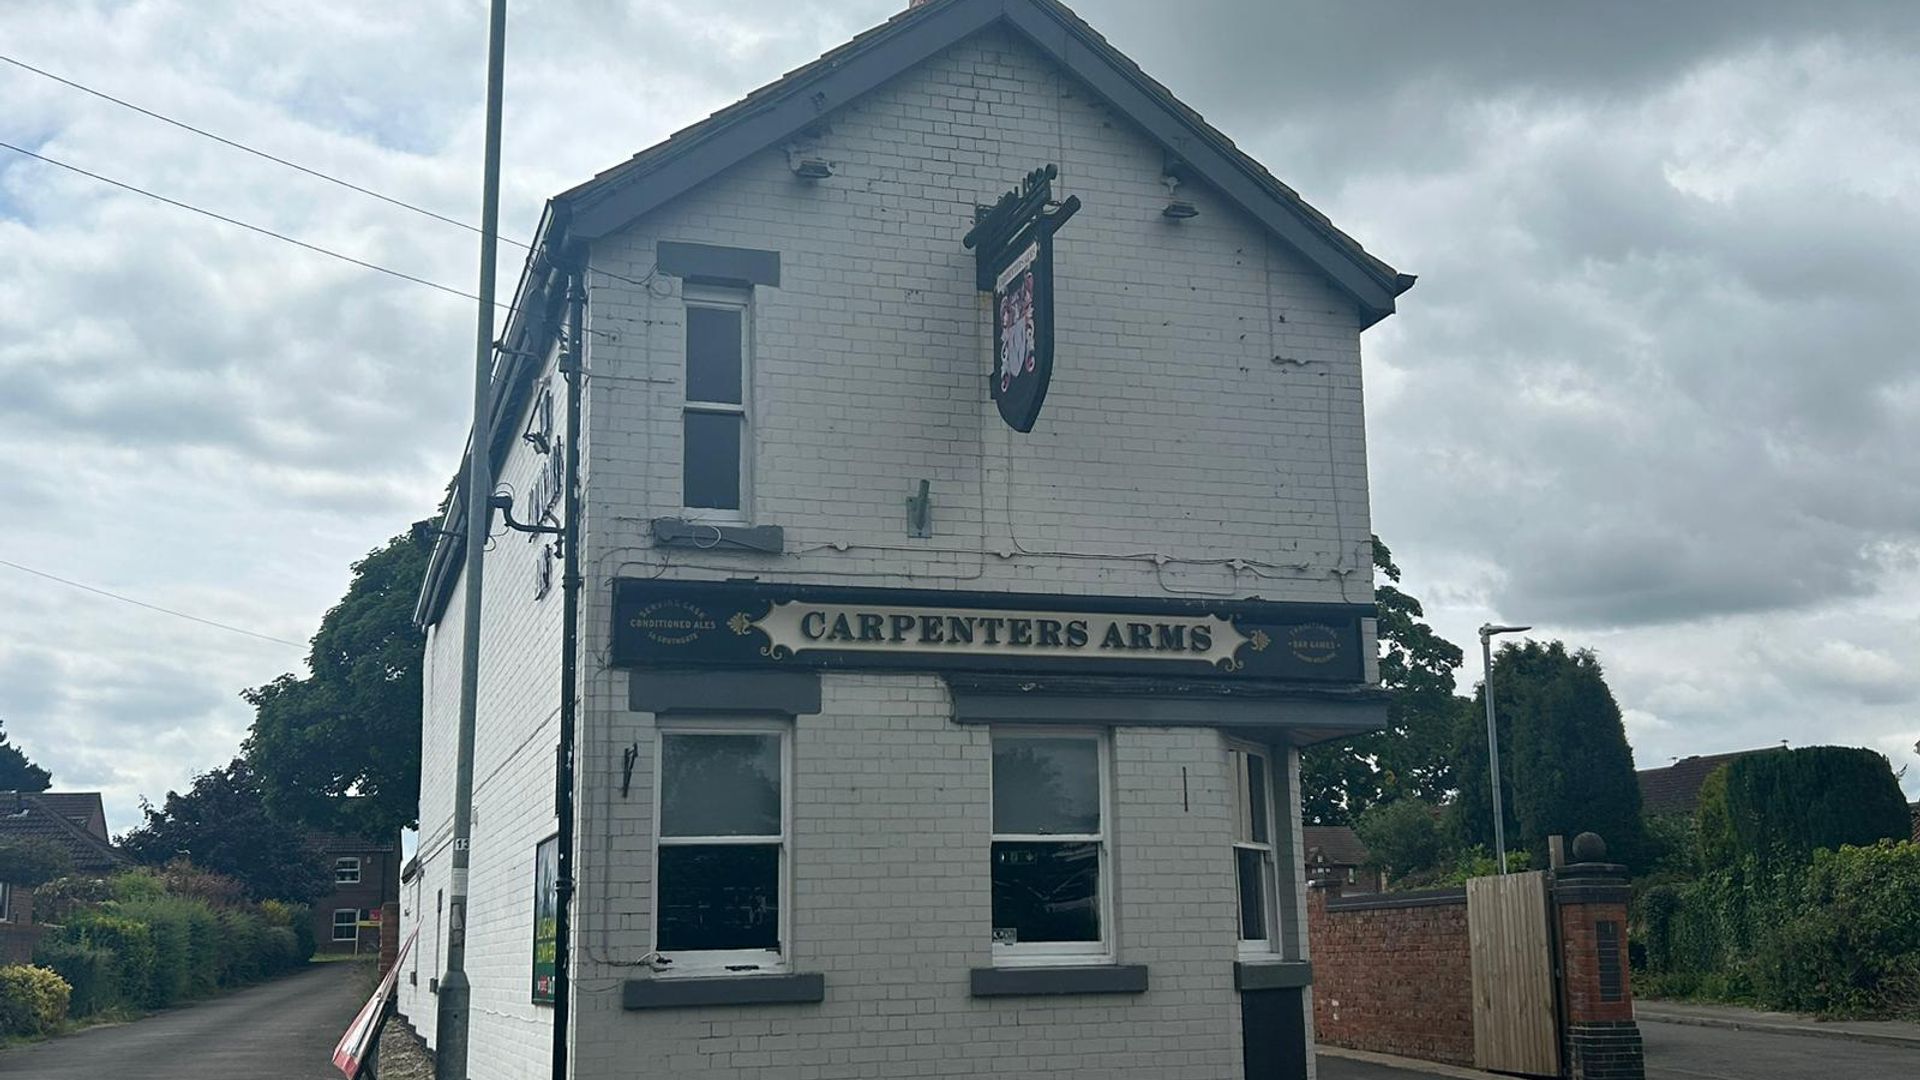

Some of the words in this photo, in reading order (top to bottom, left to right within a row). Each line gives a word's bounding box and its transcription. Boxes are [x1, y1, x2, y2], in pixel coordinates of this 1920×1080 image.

[630, 619, 692, 629] CONDITIONED
[693, 620, 716, 630] ALES
[801, 612, 1089, 648] CARPENTERS
[1100, 622, 1213, 652] ARMS
